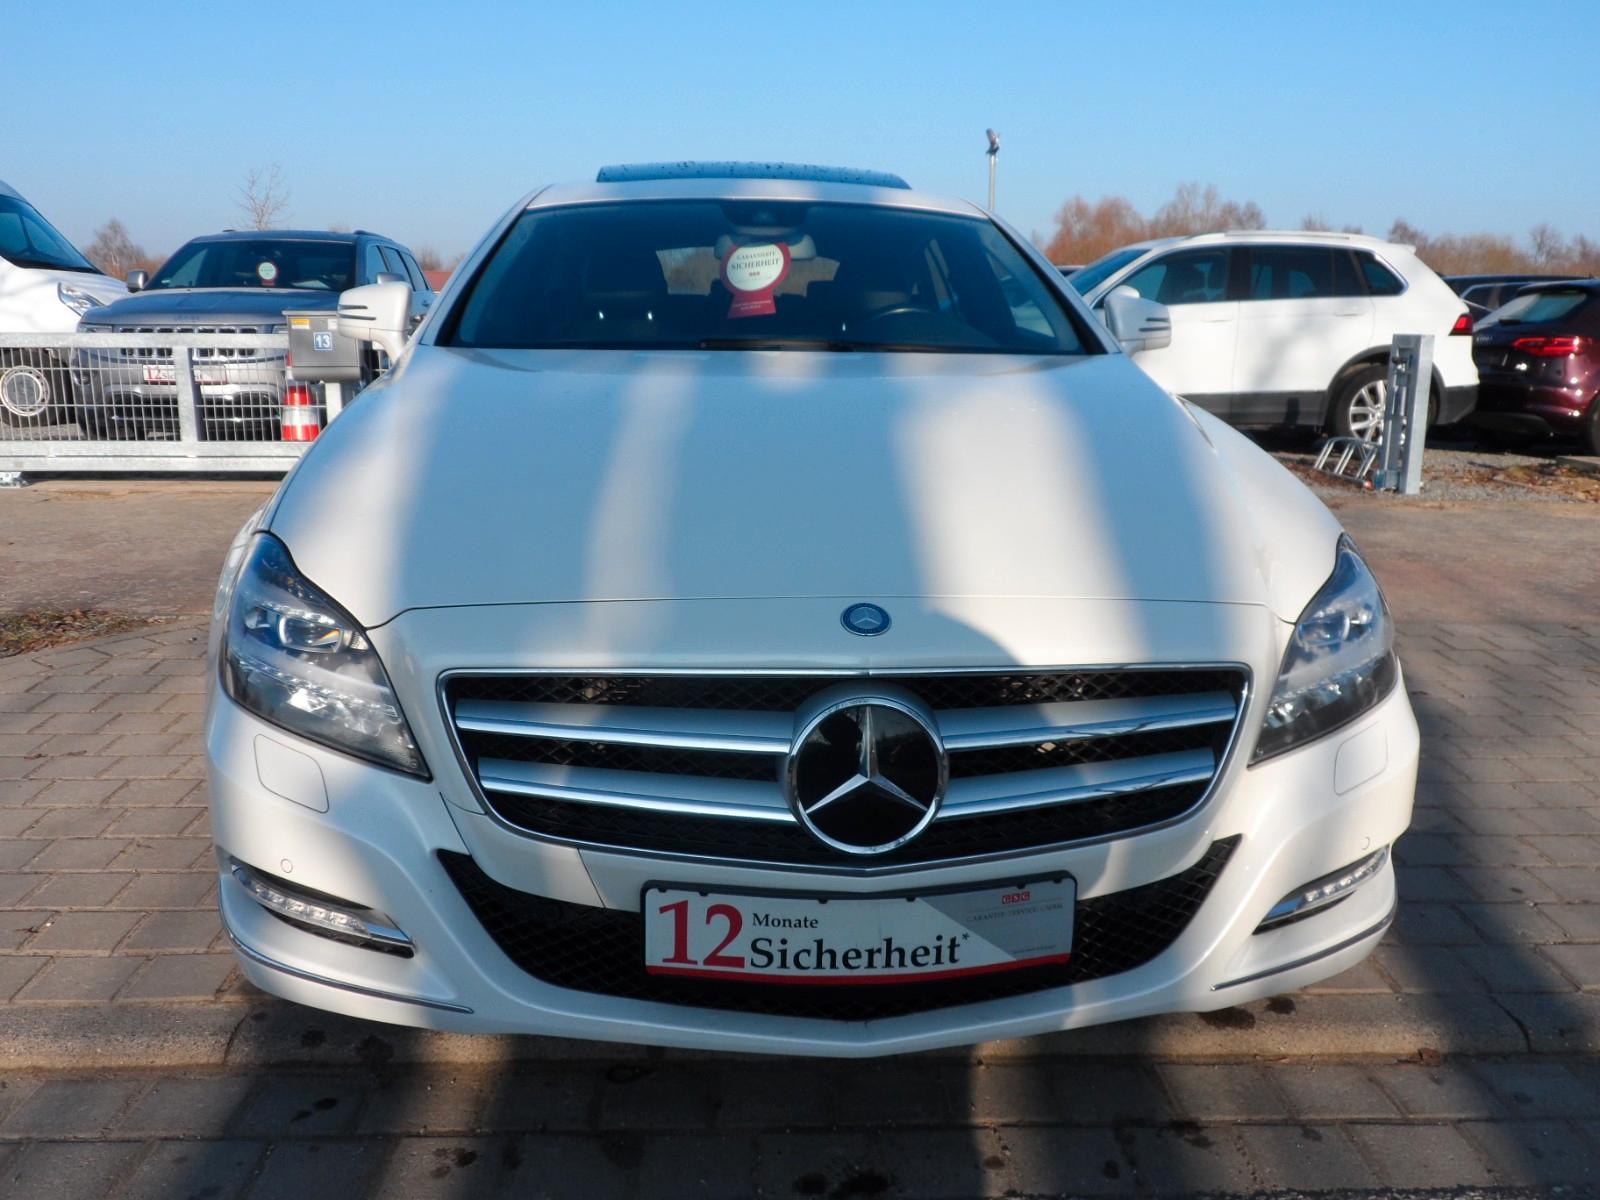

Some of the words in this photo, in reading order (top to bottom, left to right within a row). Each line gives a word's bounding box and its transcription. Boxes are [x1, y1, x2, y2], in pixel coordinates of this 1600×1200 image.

[731, 258, 779, 271] SICHERHEIT
[315, 334, 330, 349] 13
[751, 912, 819, 930] Monate
[658, 899, 746, 969] 12
